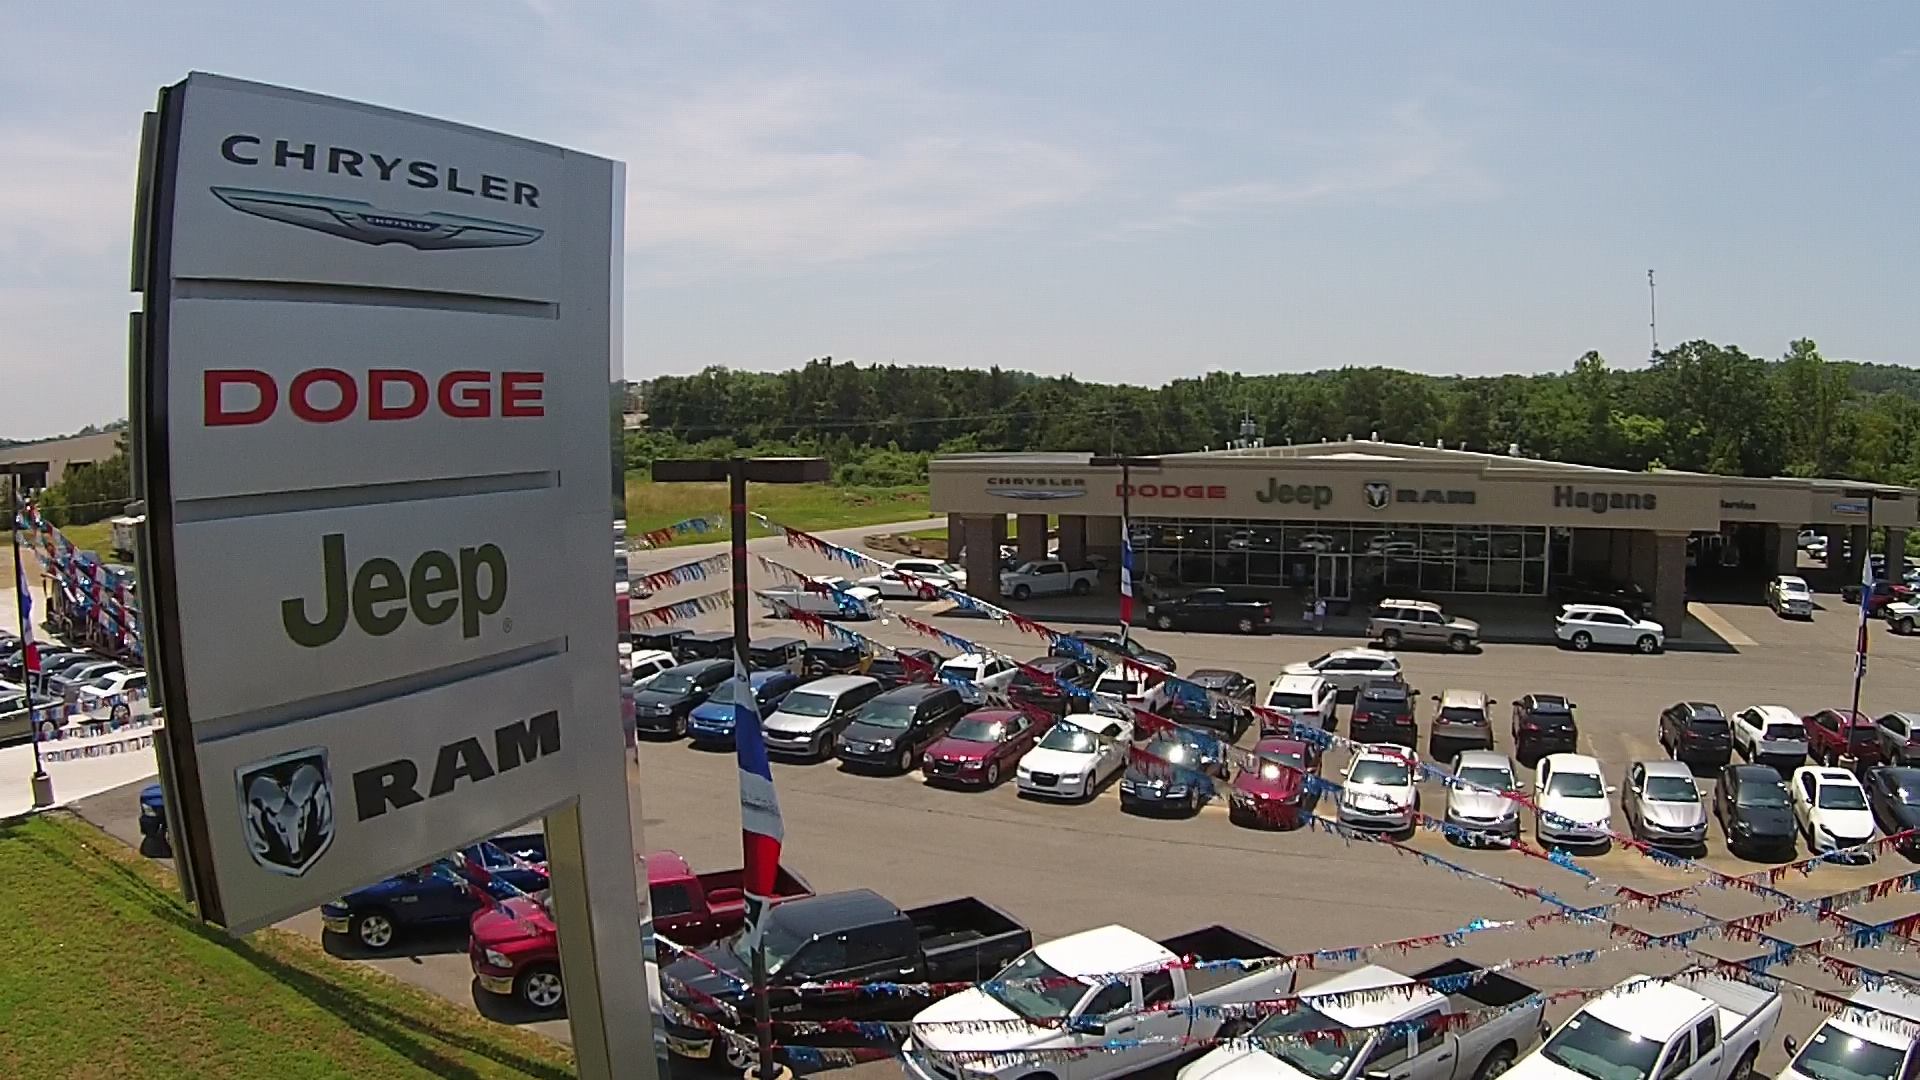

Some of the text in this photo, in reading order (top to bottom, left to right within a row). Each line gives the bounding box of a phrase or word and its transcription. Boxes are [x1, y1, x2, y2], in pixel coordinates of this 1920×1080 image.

[221, 134, 541, 209] CHRYSLER
[204, 368, 545, 427] DODGE
[987, 476, 1086, 486] CHRYSLER
[1115, 484, 1227, 499] DODGE
[1256, 477, 1333, 510] Jeep
[1397, 489, 1476, 505] RAM
[1553, 485, 1656, 514] Hagans
[282, 533, 508, 648] Jeep
[351, 710, 561, 822] RAM
